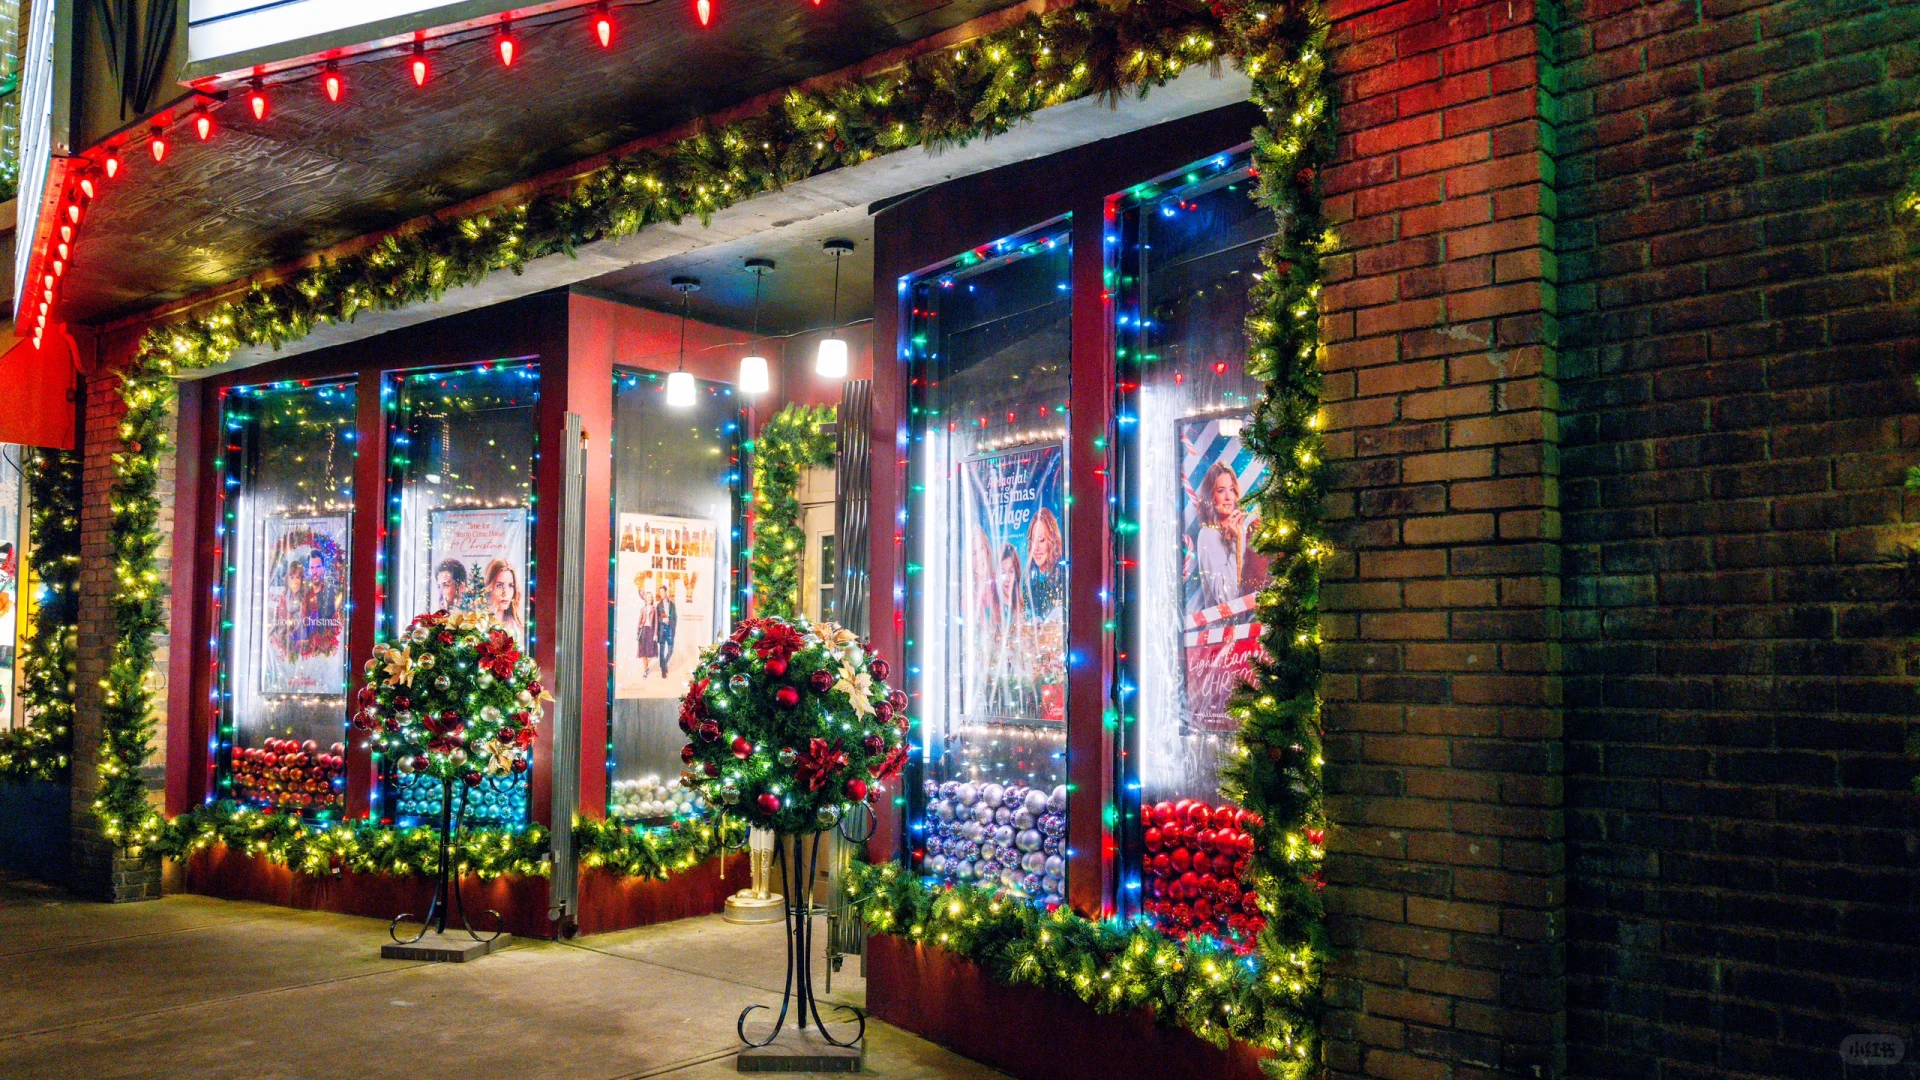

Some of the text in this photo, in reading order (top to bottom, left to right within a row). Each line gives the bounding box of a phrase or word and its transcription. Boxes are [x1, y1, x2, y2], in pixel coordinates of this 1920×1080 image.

[995, 469, 1027, 492] Magial
[460, 537, 507, 553] Christmas
[619, 522, 716, 558] AUTUMN
[652, 556, 687, 571] IN THE
[634, 570, 699, 604] CITY
[302, 614, 341, 627] Christmas
[1195, 708, 1232, 722] Hallmar
